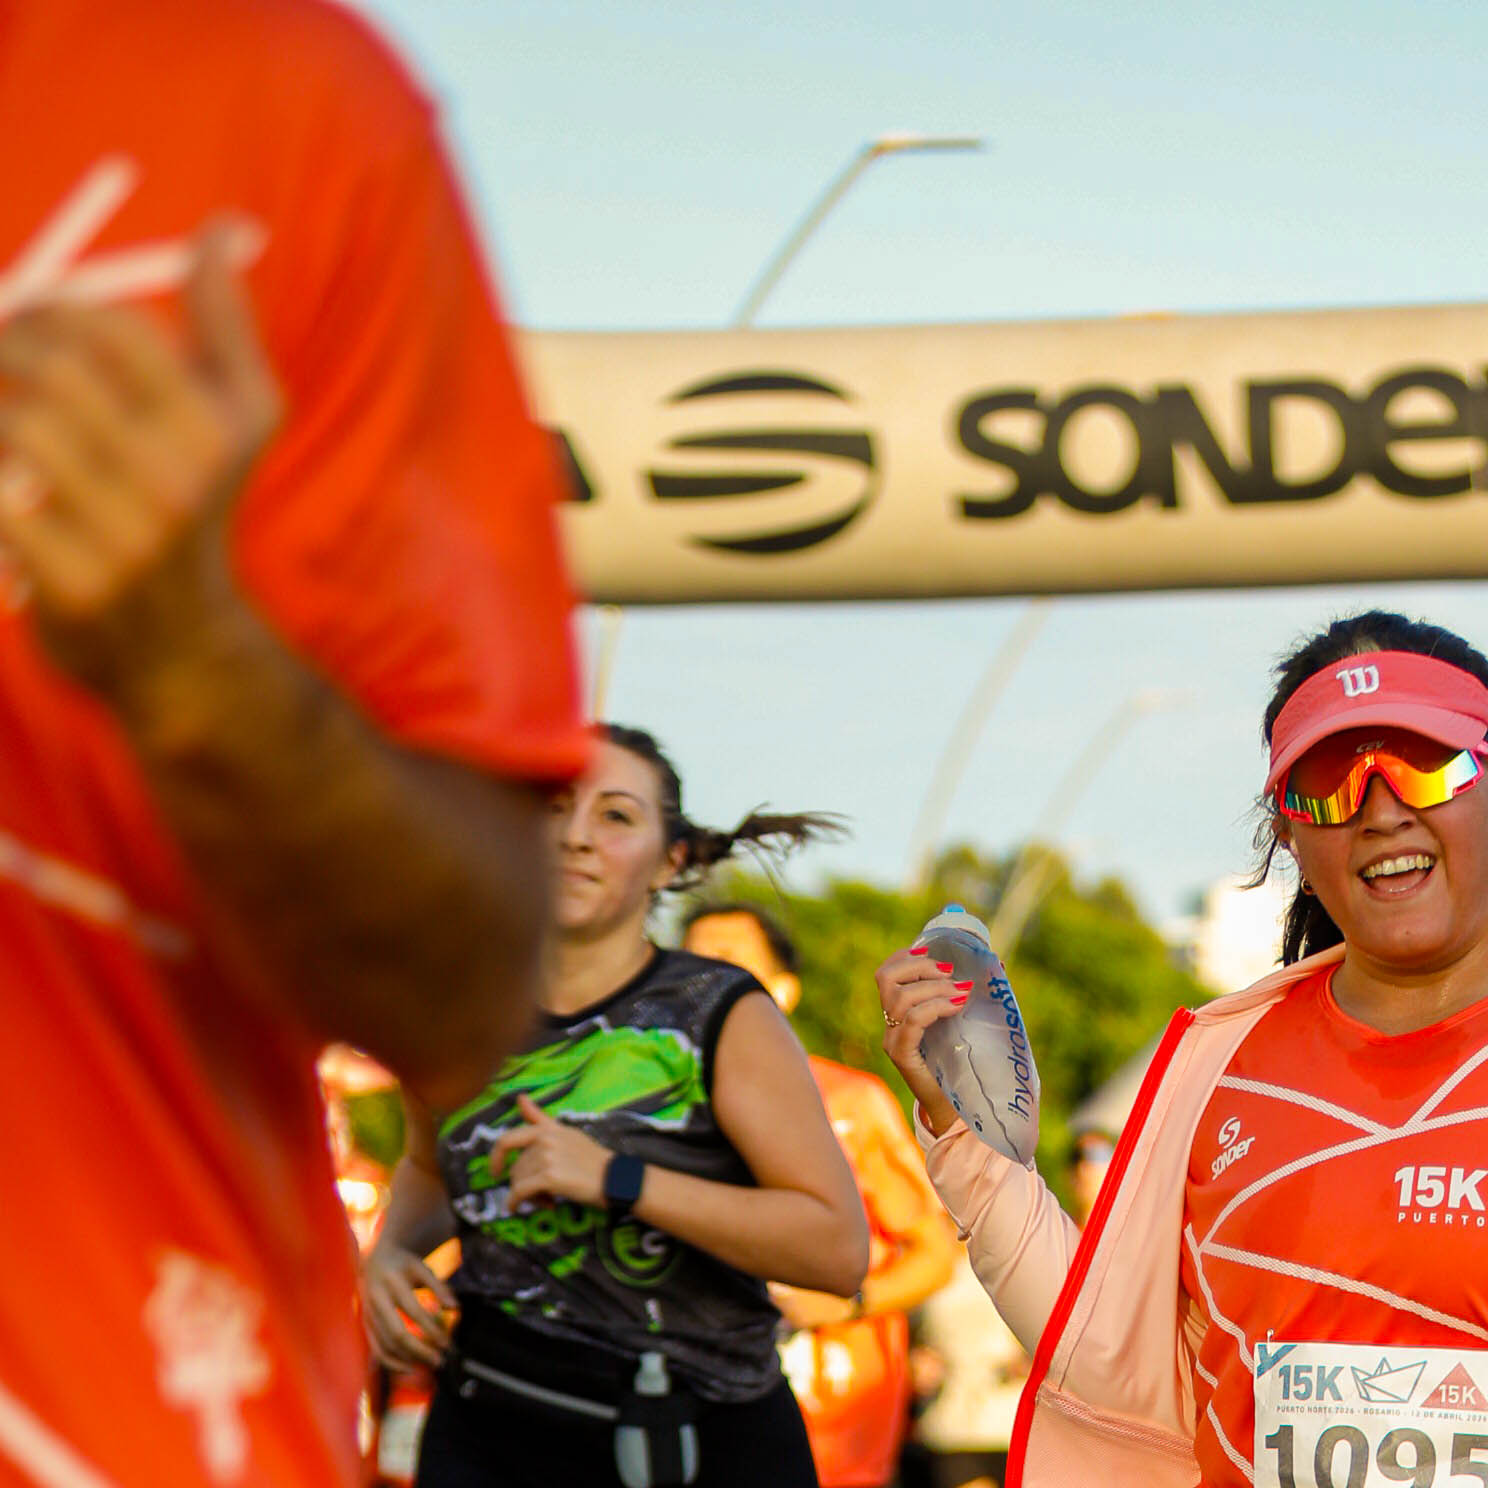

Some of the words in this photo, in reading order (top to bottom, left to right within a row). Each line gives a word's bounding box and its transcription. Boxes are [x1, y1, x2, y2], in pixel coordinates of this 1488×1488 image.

[1394, 1165, 1488, 1211] 15K
[1397, 1212, 1486, 1228] PUERTO
[1278, 1364, 1344, 1401] 15K
[1438, 1384, 1477, 1406] 15K
[1276, 1405, 1305, 1414] PUERTO
[1307, 1406, 1332, 1415] NORTE
[1363, 1407, 1401, 1417] ROSARIO
[1437, 1411, 1463, 1420] ABRIL
